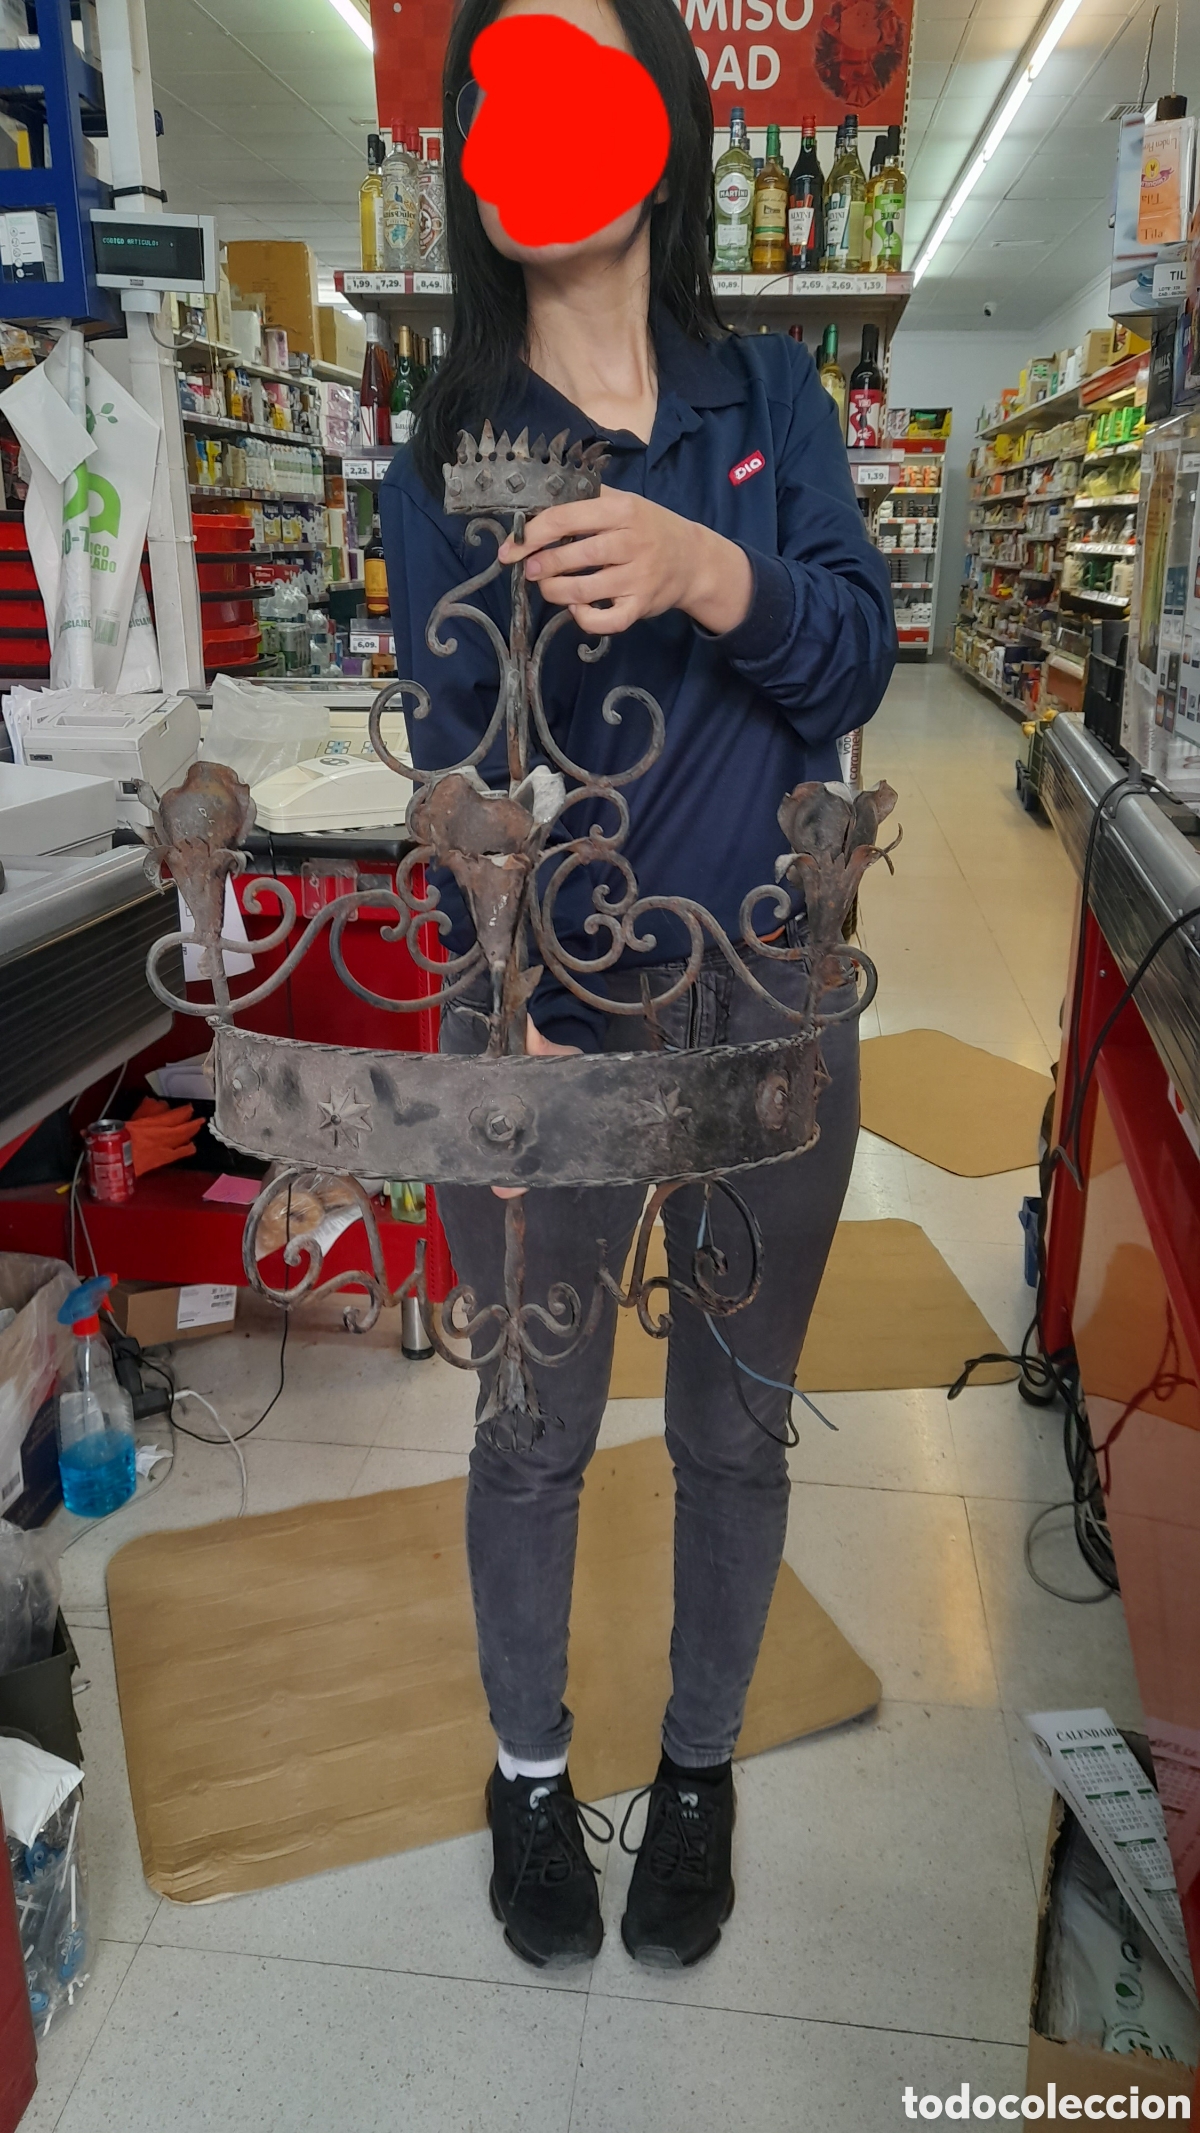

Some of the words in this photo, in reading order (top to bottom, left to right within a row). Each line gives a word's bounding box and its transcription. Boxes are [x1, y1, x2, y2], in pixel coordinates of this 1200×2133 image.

[670, 0, 814, 31] MISO
[719, 189, 748, 199] MARTINI
[1056, 1727, 1119, 1742] CALENDARI
